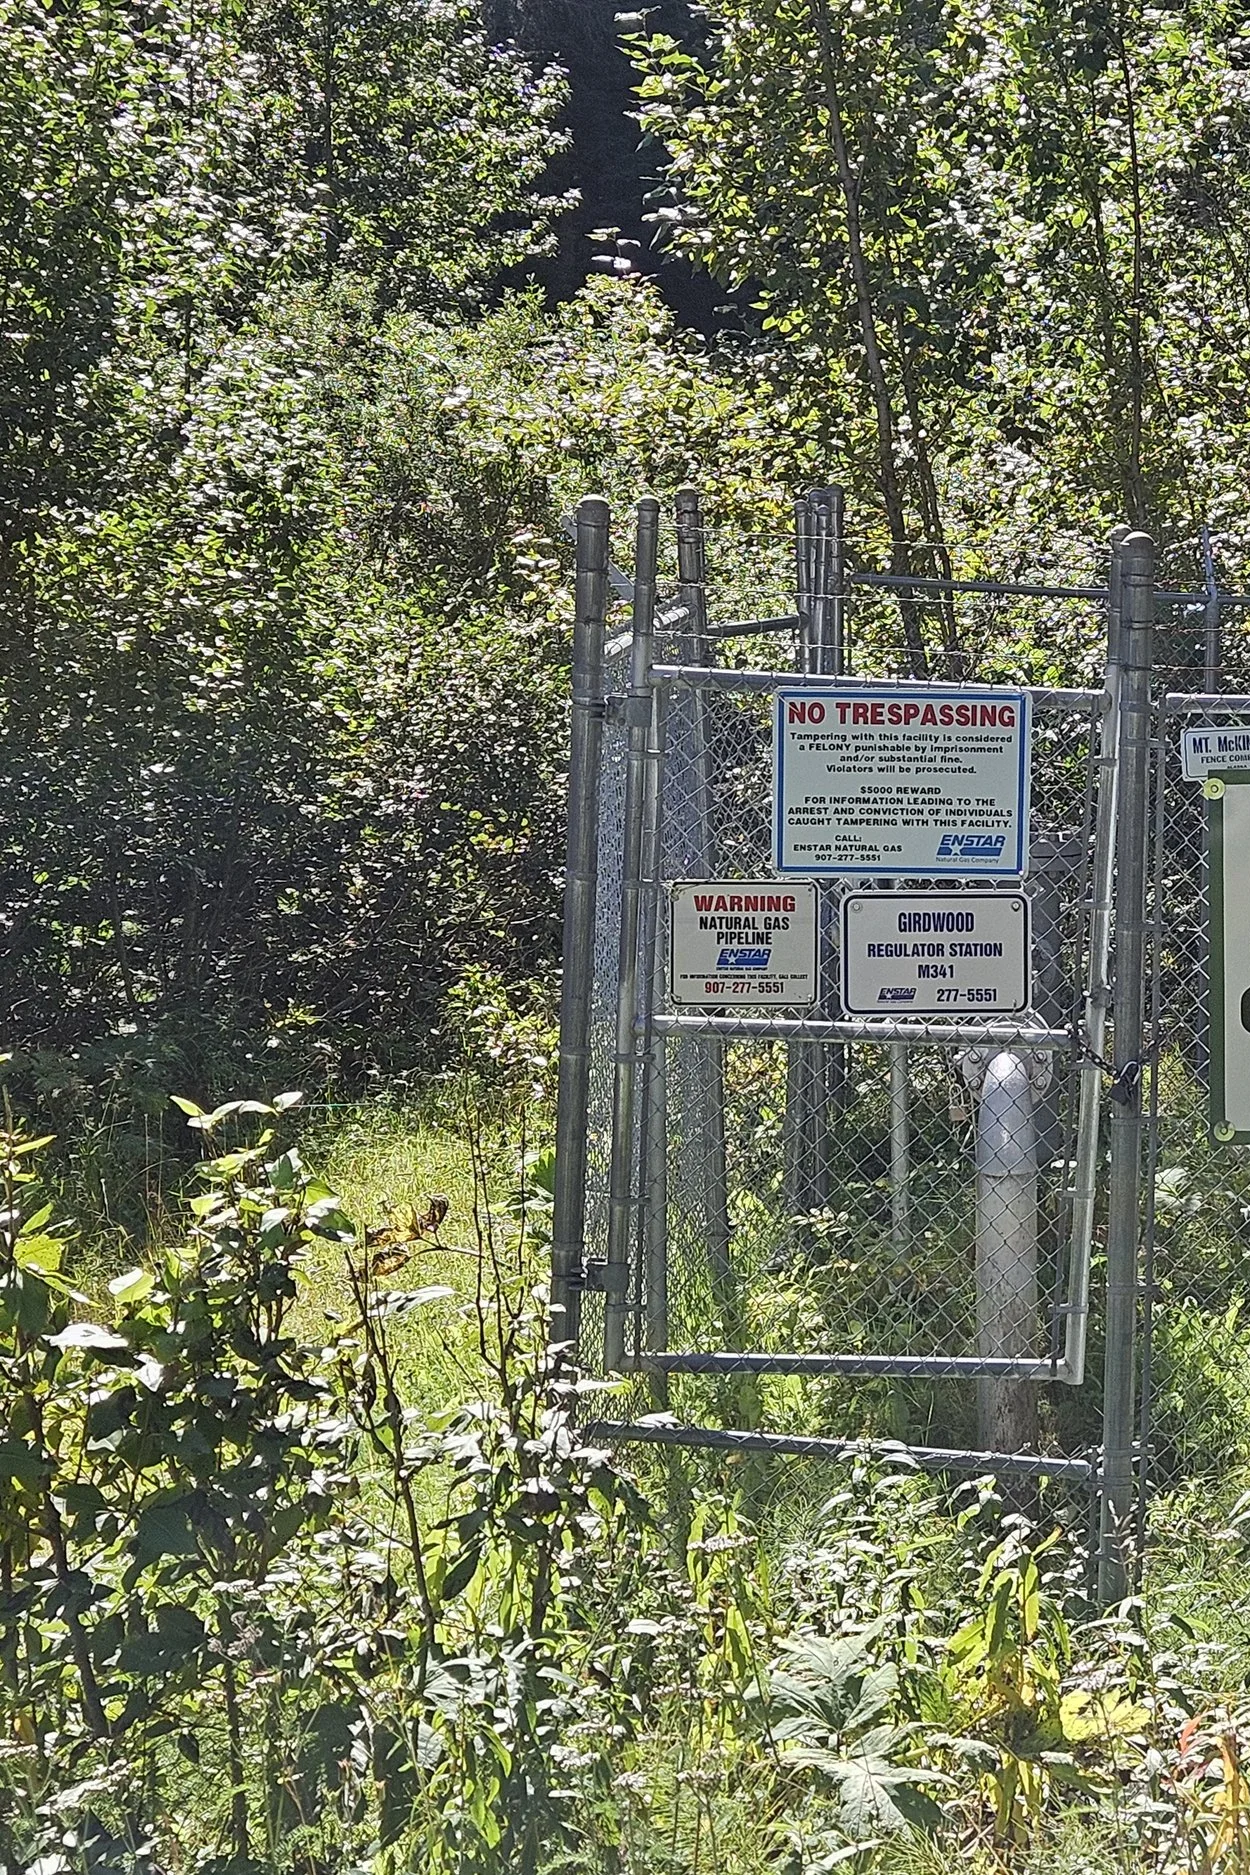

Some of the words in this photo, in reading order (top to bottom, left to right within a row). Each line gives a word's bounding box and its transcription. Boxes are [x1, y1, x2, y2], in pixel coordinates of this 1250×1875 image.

[788, 702, 825, 724] NO
[836, 702, 1015, 727] TRESPASSING
[790, 732, 847, 742] Tampering
[851, 732, 874, 741] with
[879, 733, 899, 741] this
[902, 733, 940, 744] facility
[943, 734, 952, 742] is
[955, 734, 1013, 743] considered
[809, 743, 851, 751] FELONY
[854, 743, 911, 753] punishable
[915, 744, 927, 754] by
[930, 745, 1003, 754] imprisonment
[1193, 736, 1212, 754] MT.
[878, 755, 936, 763] substantial
[940, 755, 962, 763] fine.
[1200, 755, 1226, 764] FENCE
[826, 764, 873, 773] Violators
[877, 765, 895, 773] will
[899, 765, 911, 773] be
[915, 766, 976, 774] prosecuted.
[860, 786, 892, 794] $5000
[896, 786, 941, 794] REWARD
[804, 796, 826, 804] FOR
[829, 796, 903, 805] INFORMATION
[907, 797, 953, 806] LEADING
[956, 798, 971, 806] TO
[975, 798, 996, 806] THE
[788, 807, 829, 815] ARREST
[833, 807, 855, 815] AND
[858, 807, 924, 816] CONVICTION
[928, 808, 942, 816] OF
[945, 808, 1013, 817] INDIVIDUALS
[788, 818, 832, 826] CAUGHT
[836, 818, 898, 826] TAMPERING
[933, 819, 957, 827] THIS
[961, 819, 1012, 828] FACILITY.
[940, 834, 1006, 846] ENSTAR
[793, 844, 831, 852] ENSTAR
[834, 844, 880, 852] NATURAL
[694, 895, 796, 912] WARNING
[699, 916, 759, 930] NATURAL
[764, 916, 790, 930] GAS
[898, 912, 974, 933] GIRDWOOD
[716, 932, 772, 945] PIPELINE
[720, 948, 772, 958] ENSTAR
[867, 943, 945, 957] REGULATOR
[948, 943, 1003, 957] STATION
[918, 964, 954, 978] M341
[705, 982, 784, 993] 907-277-5551
[880, 988, 917, 996] ENSTAR
[936, 988, 997, 1002] 277-5551
